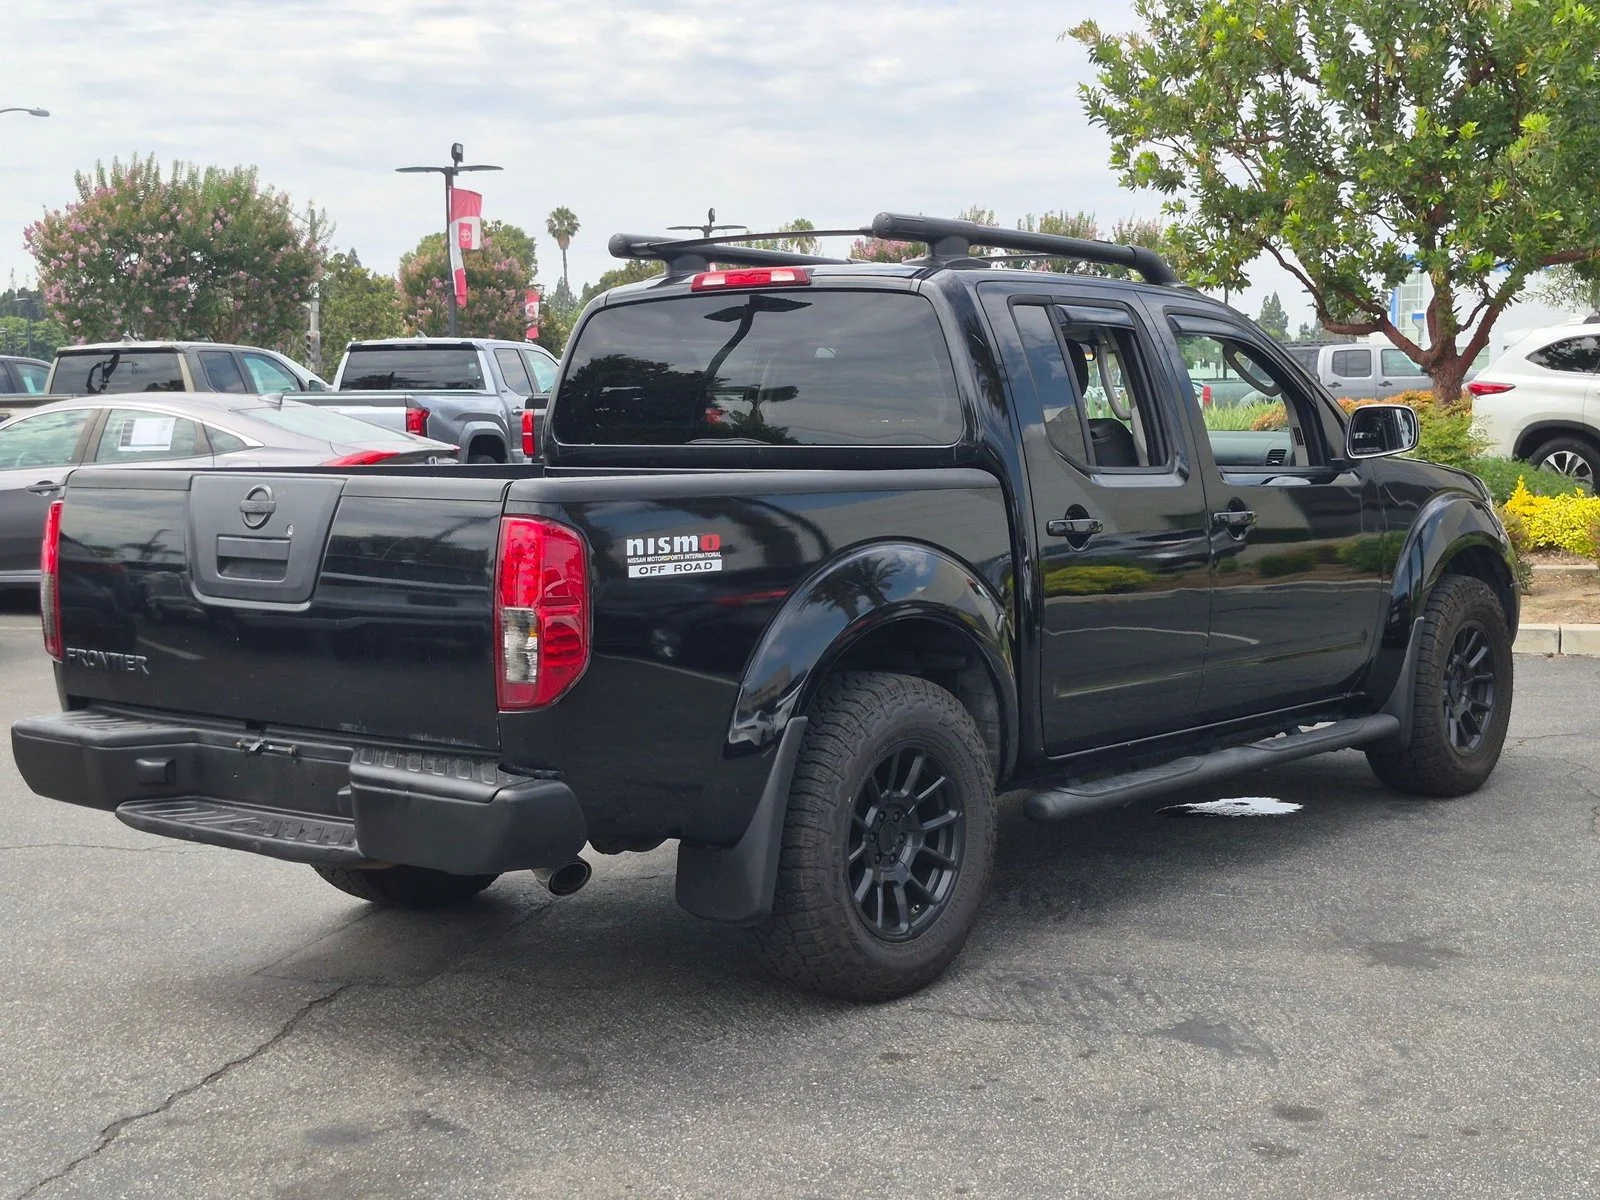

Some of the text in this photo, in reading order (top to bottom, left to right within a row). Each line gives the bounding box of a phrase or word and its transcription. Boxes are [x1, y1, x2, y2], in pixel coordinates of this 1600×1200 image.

[627, 552, 722, 564] NISSAN MOTORSPORTS INTERNATIONAL
[638, 562, 713, 575] OFF ROAD
[65, 647, 149, 675] FRONTIER
